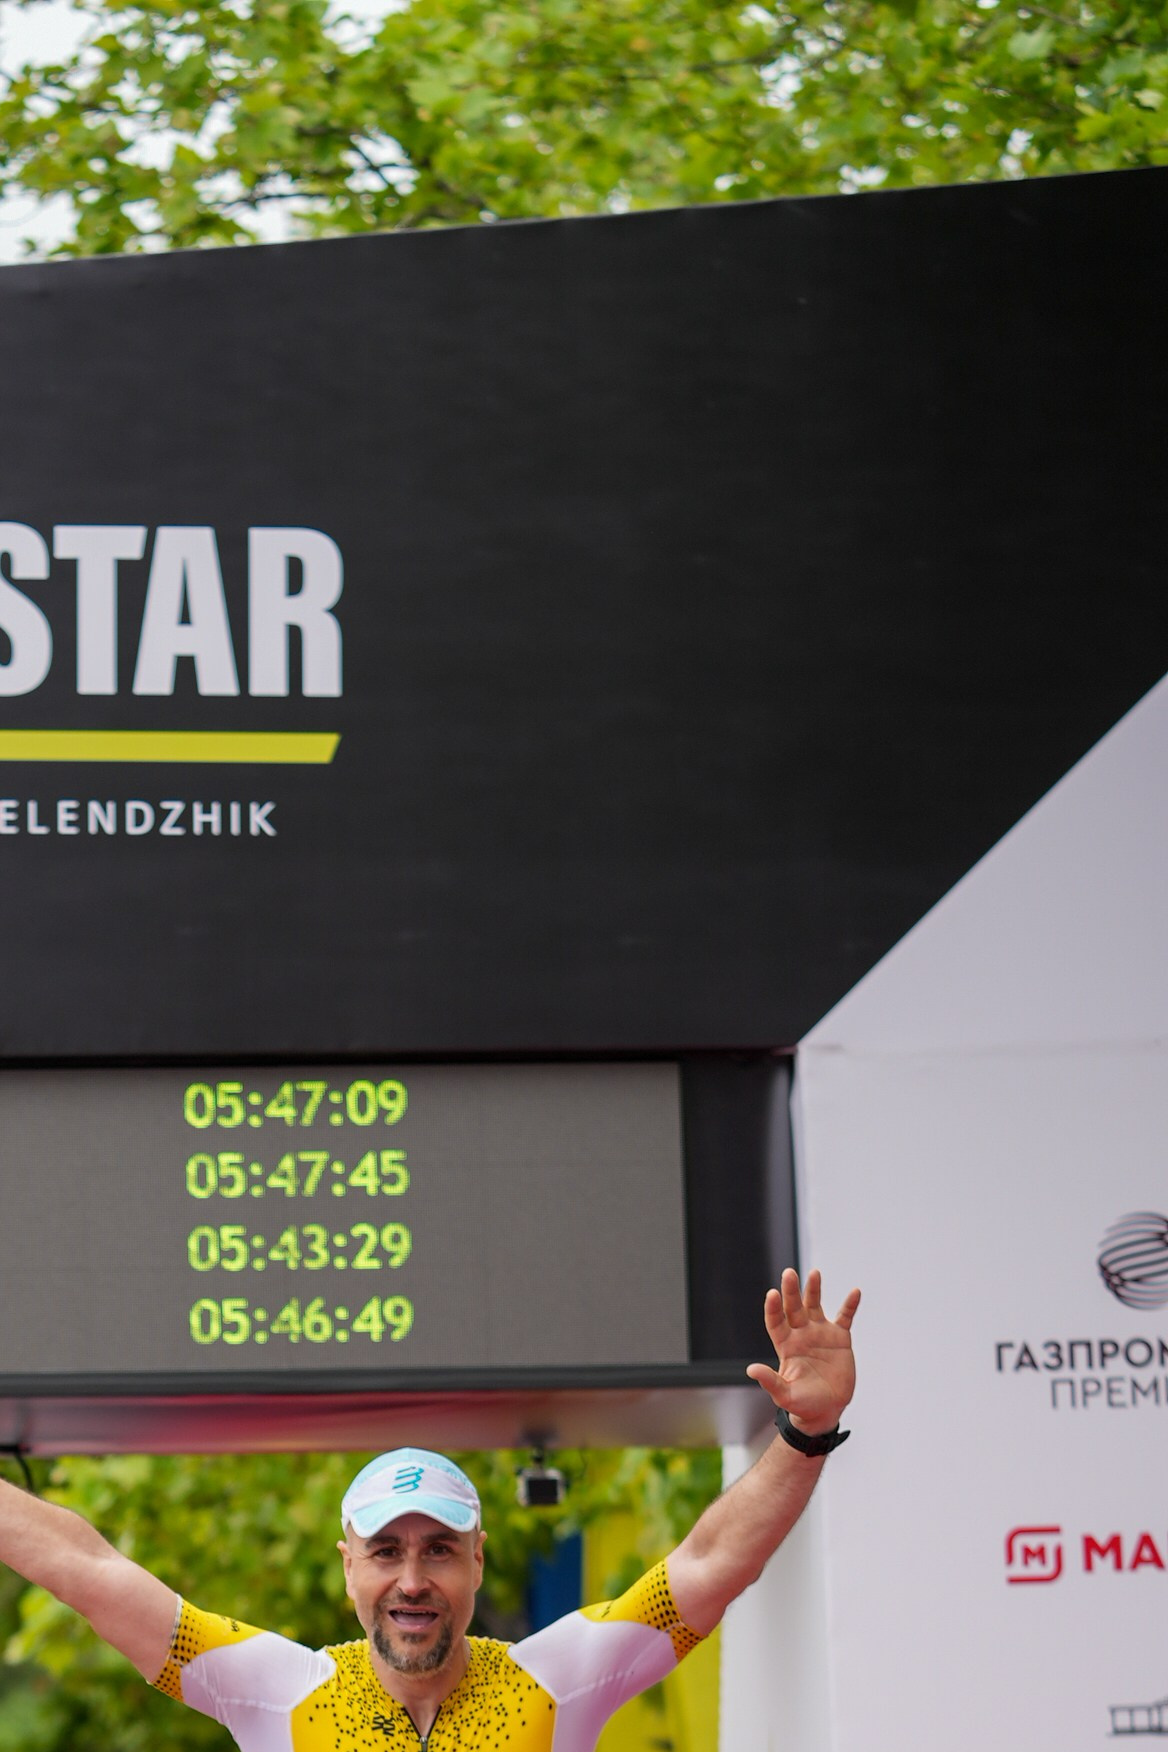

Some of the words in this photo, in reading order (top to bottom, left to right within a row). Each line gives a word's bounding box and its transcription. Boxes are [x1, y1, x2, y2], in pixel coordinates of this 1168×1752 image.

[183, 1080, 409, 1129] 05:47:09
[185, 1150, 411, 1199] 05:47:45
[187, 1223, 413, 1272] 05:43:29
[189, 1296, 415, 1345] 05:46:49
[1051, 1376, 1168, 1409] ПРЕМ
